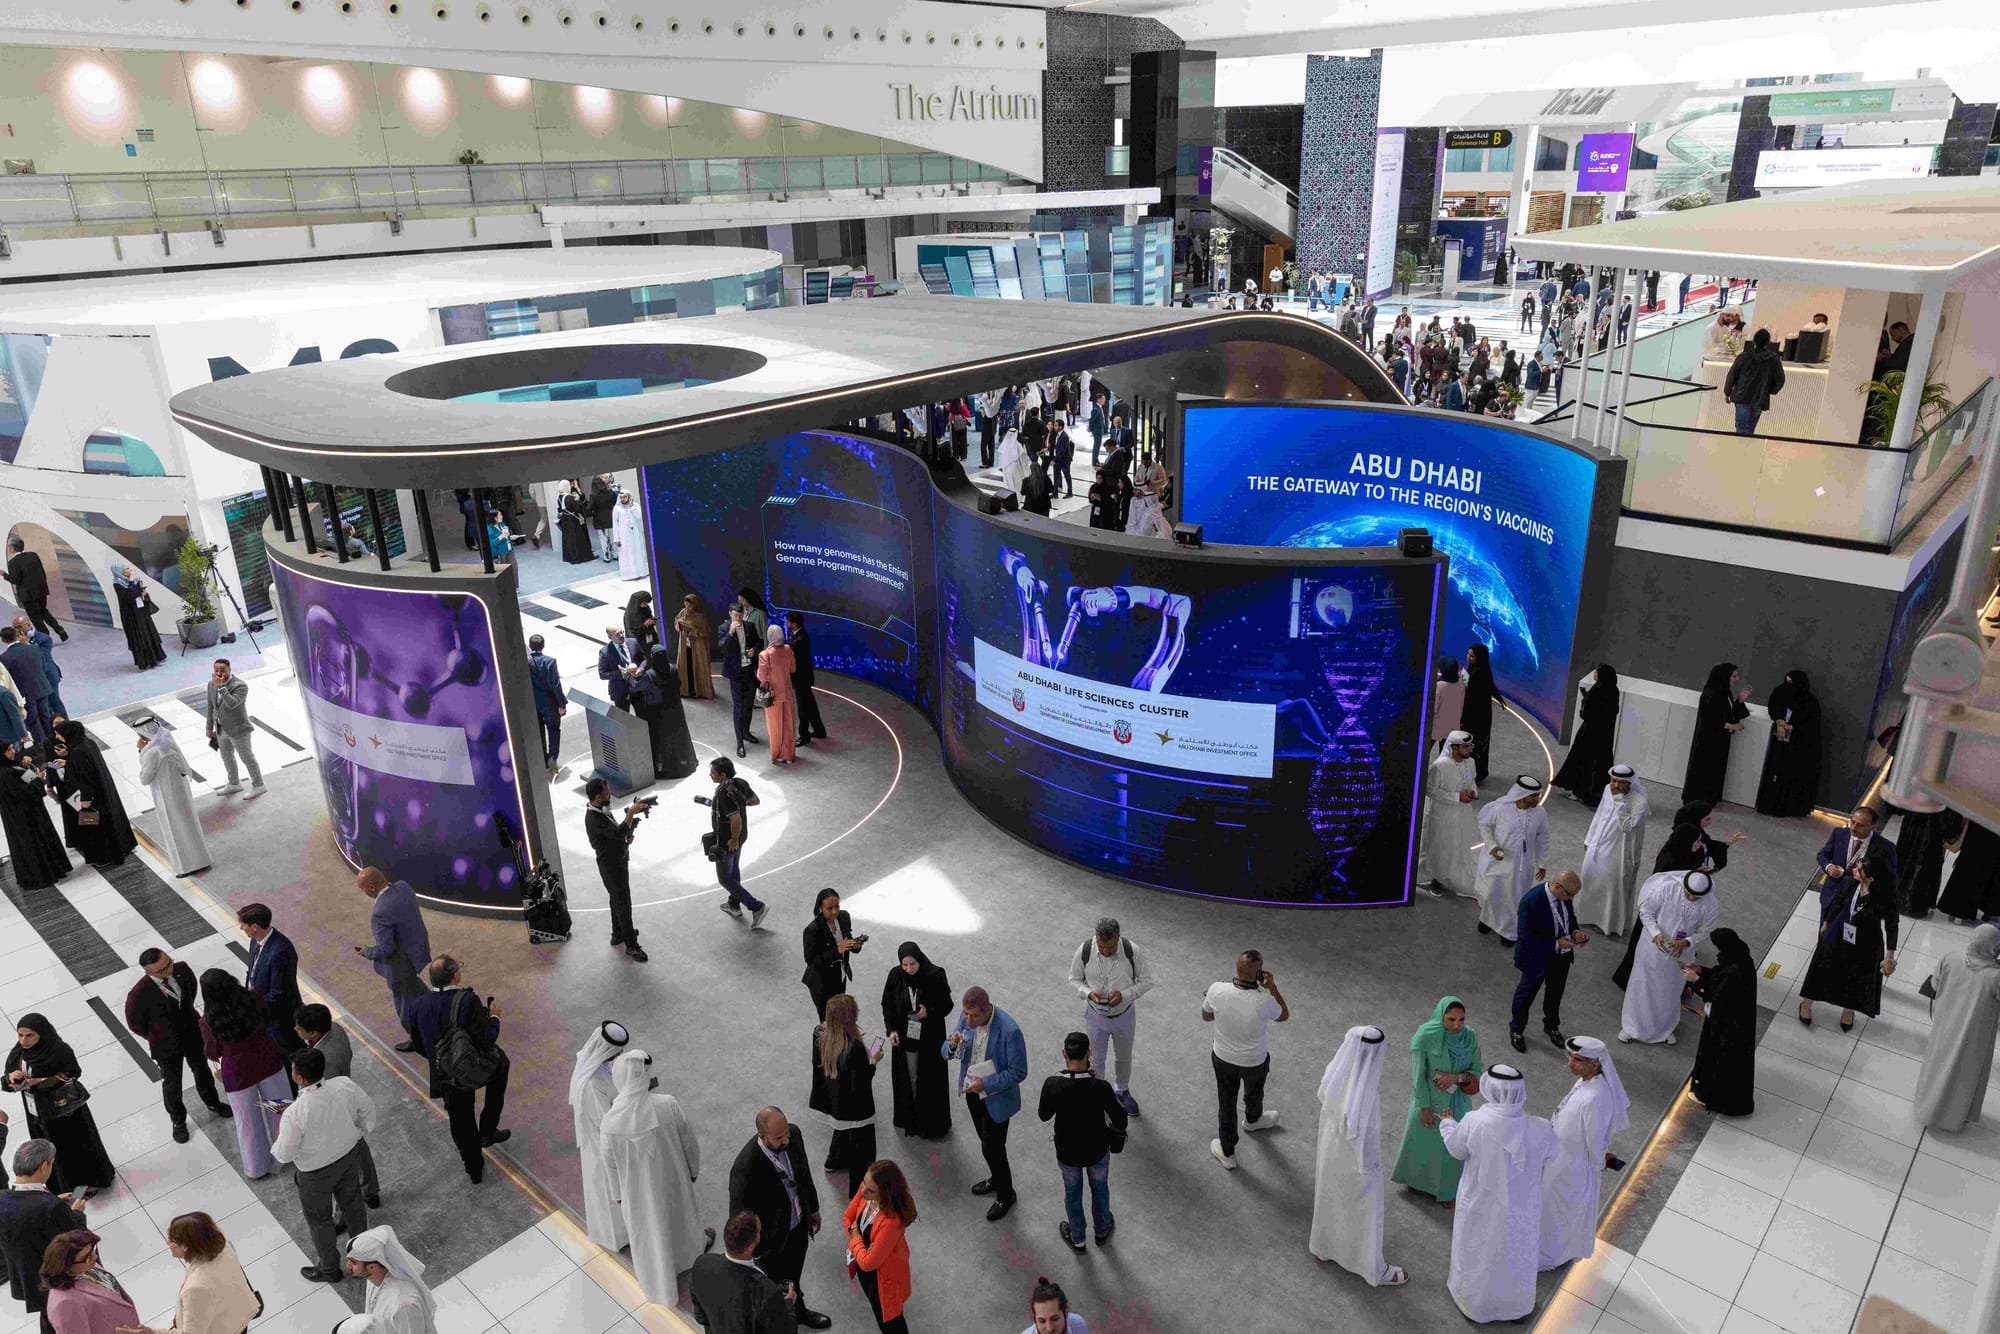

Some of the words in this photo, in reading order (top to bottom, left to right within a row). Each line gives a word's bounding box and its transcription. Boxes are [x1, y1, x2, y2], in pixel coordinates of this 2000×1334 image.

[888, 83, 944, 120] The
[949, 84, 1037, 120] Atrium
[1540, 88, 1581, 115] The
[1493, 132, 1502, 145] B
[1348, 452, 1402, 479] ABU
[1409, 459, 1482, 494] DHABI
[1248, 476, 1279, 491] THE
[1283, 477, 1359, 497] GATEWAY
[1363, 483, 1385, 500] TO
[1389, 486, 1420, 505] THE
[1495, 508, 1554, 545] VACCINES
[774, 540, 796, 551] How
[797, 543, 822, 555] many
[824, 547, 861, 563] genomes
[862, 554, 875, 566] has
[876, 559, 887, 569] the
[888, 563, 909, 581] Emirati
[776, 553, 816, 566] Genome
[817, 558, 865, 576] Programme
[865, 570, 905, 591] sequenced?
[1018, 670, 1034, 683] ABU
[1035, 677, 1061, 692] DHABI
[1064, 684, 1083, 699] LIFE
[1085, 691, 1134, 709] SCIENCES
[1139, 703, 1189, 719] CLUSTER
[1190, 745, 1206, 753] DHABI
[1206, 748, 1239, 757] INVESTMENT
